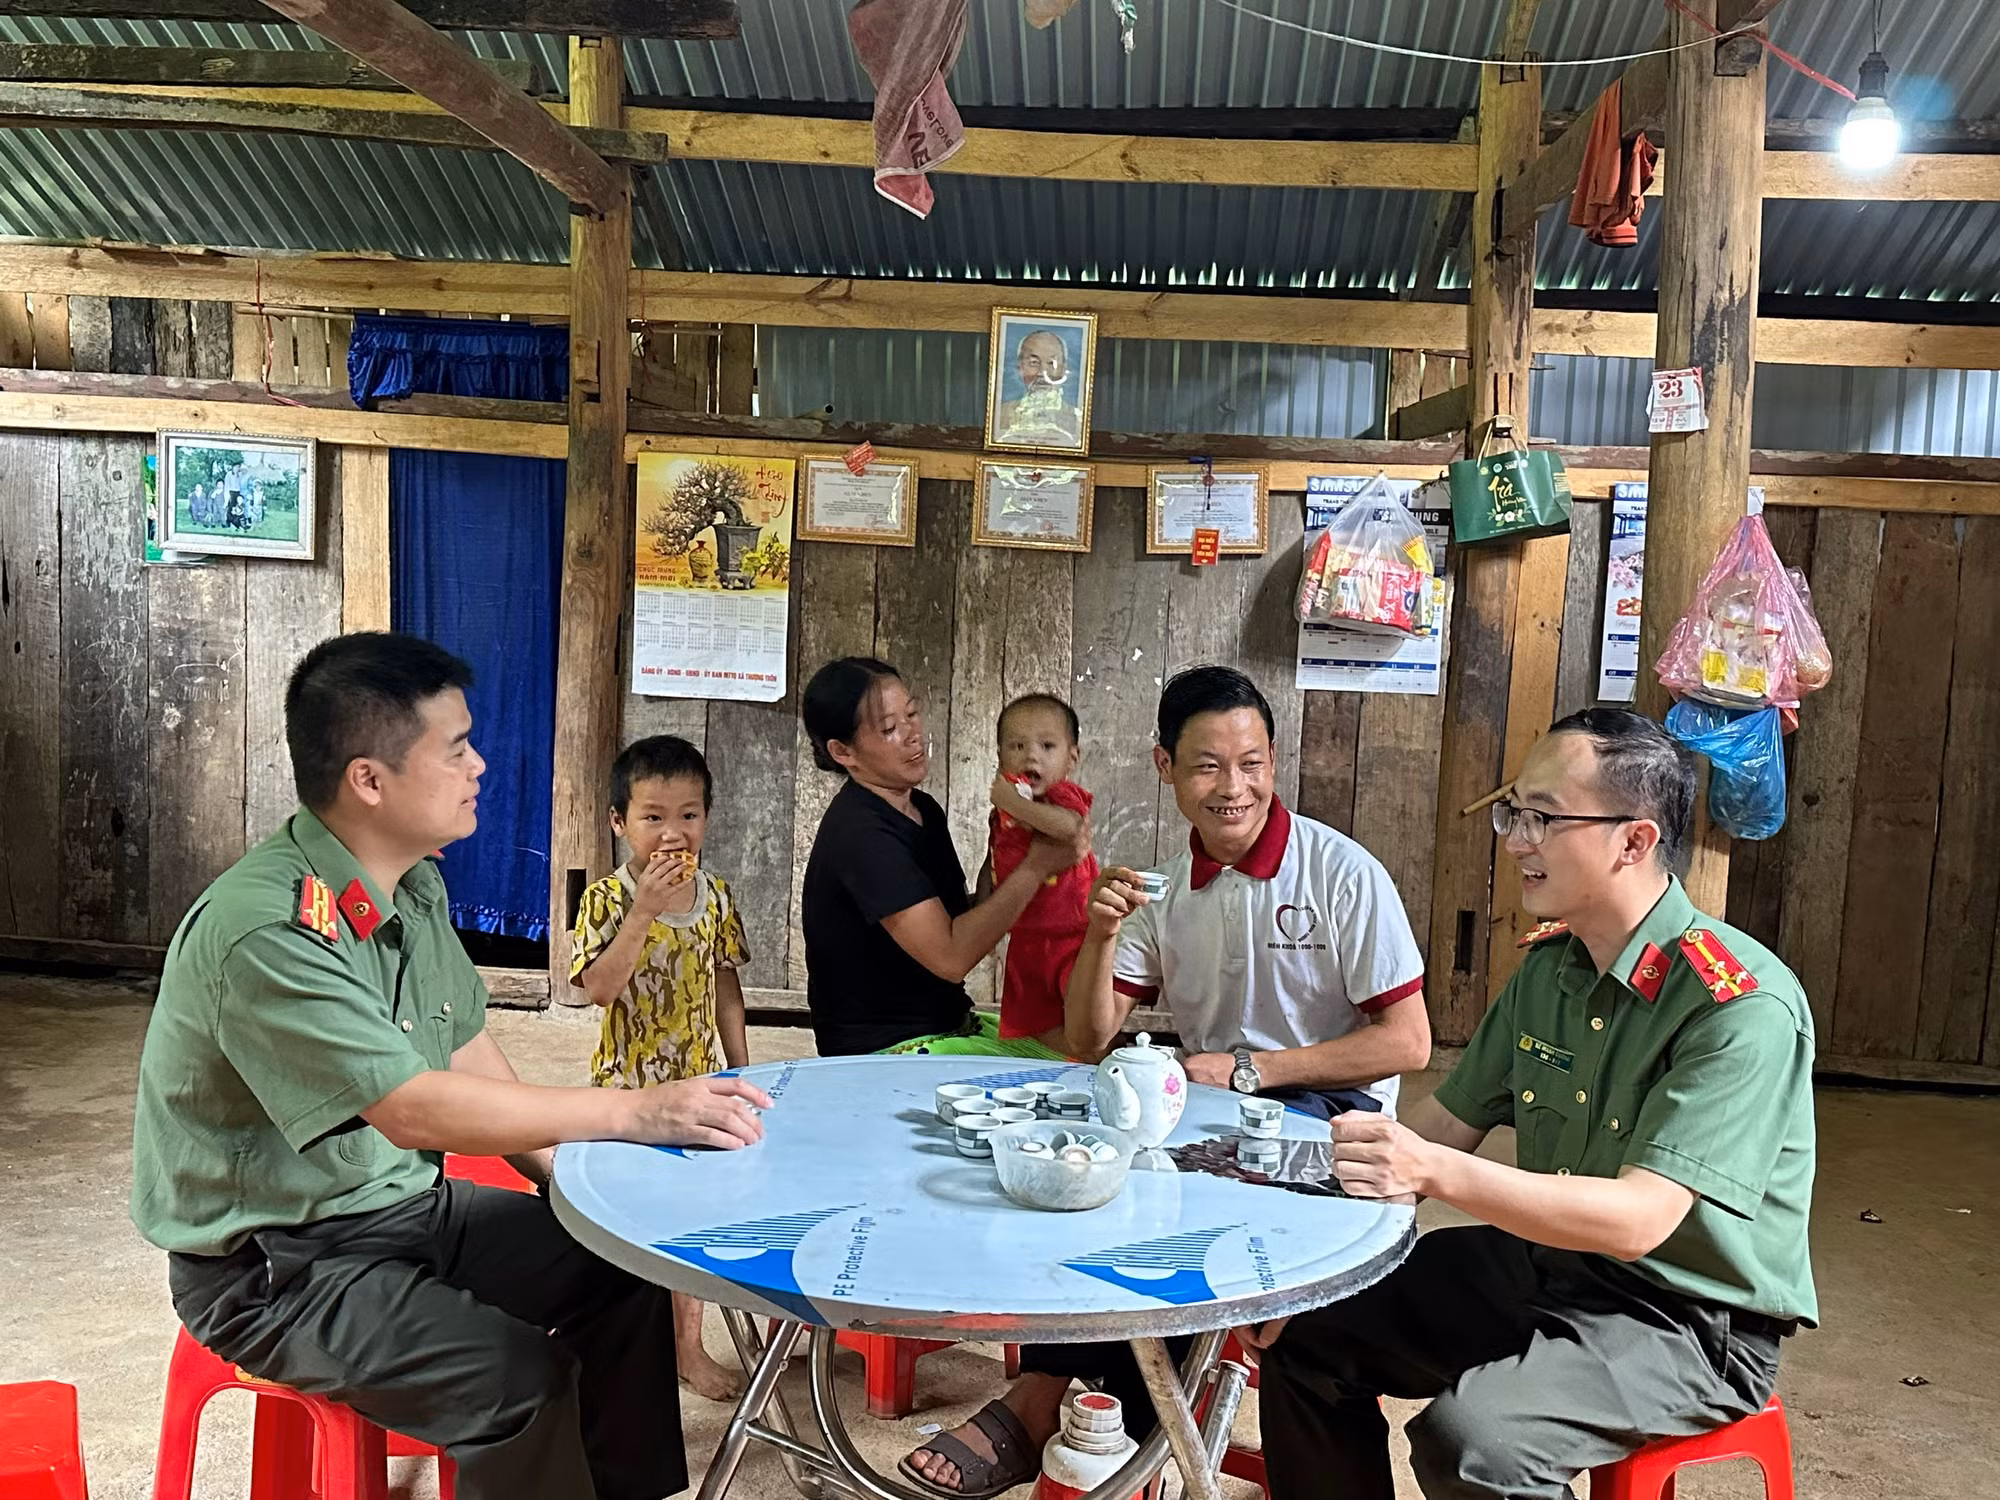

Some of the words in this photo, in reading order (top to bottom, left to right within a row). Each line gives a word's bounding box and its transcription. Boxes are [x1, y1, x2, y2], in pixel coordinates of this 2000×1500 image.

[1658, 380, 1684, 398] 23
[1488, 475, 1520, 512] Trà
[851, 1216, 877, 1234] Film
[1247, 1236, 1266, 1254] Film
[837, 1235, 868, 1281] Protective
[832, 1283, 855, 1296] PE
